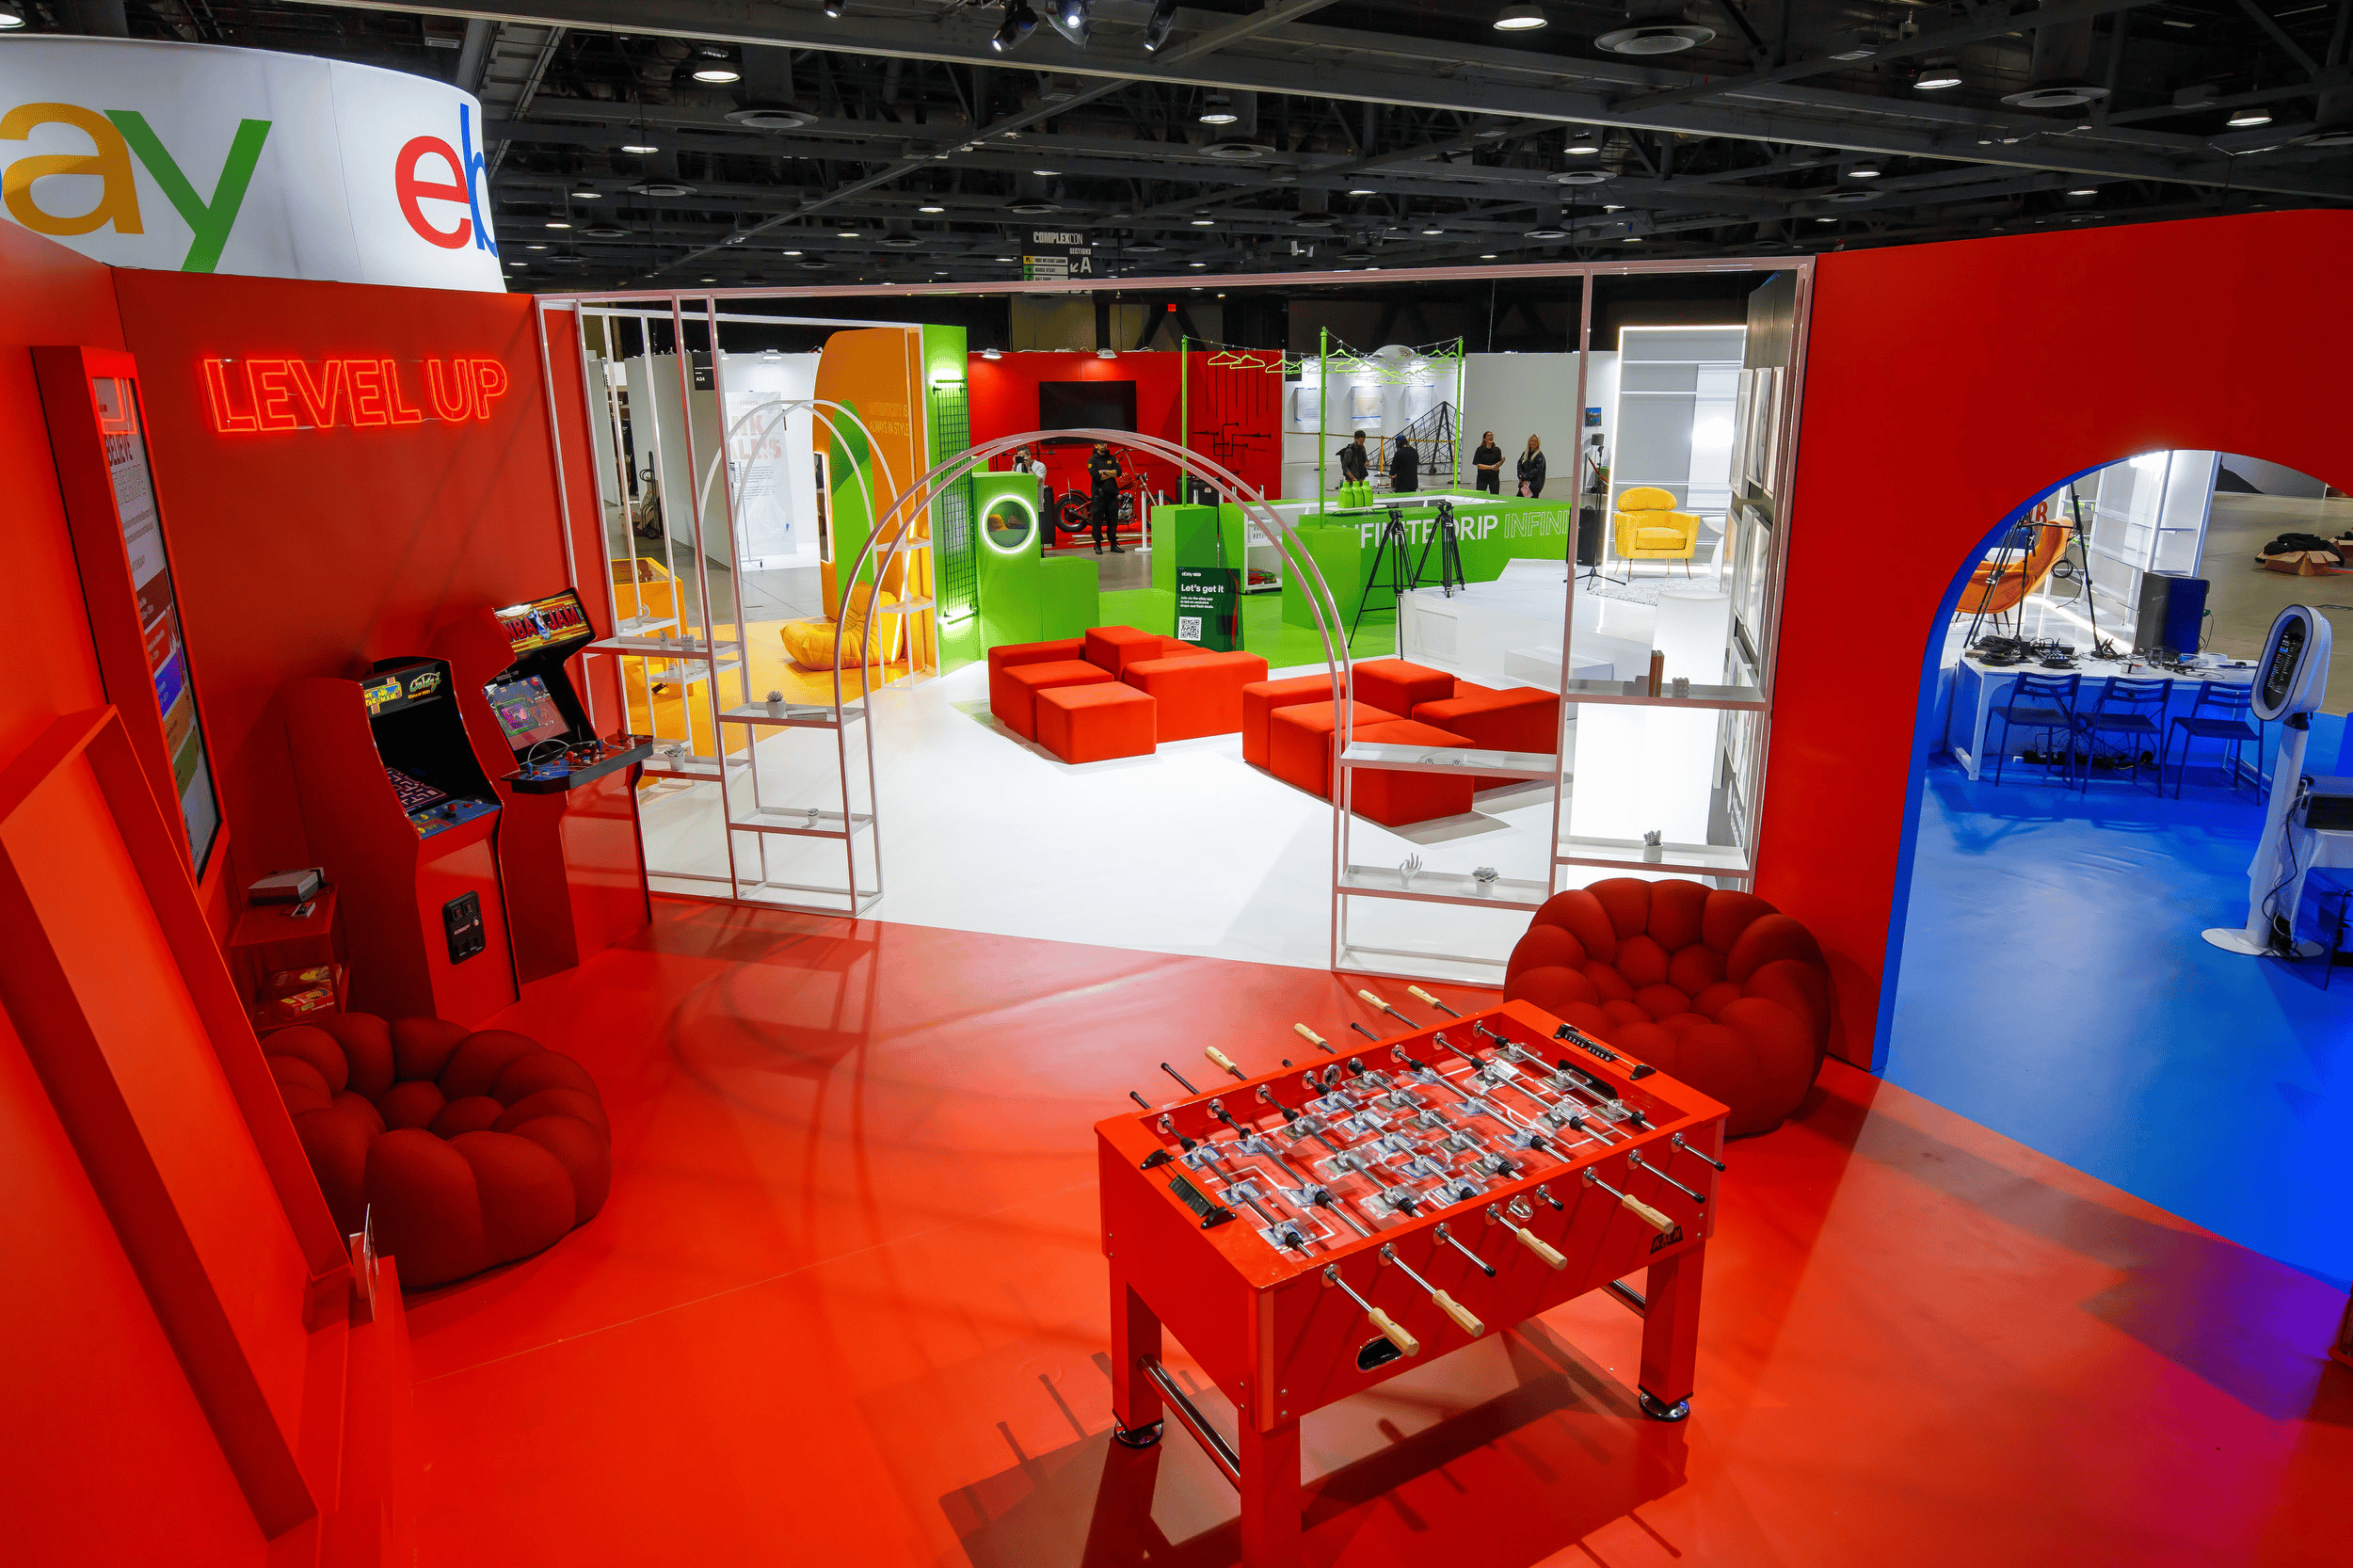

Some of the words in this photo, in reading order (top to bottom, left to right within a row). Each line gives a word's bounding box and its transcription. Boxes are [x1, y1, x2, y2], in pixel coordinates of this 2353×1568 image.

[0, 102, 272, 272] ay
[1033, 232, 1083, 245] COMPLEXCON
[1080, 256, 1092, 274] A
[203, 358, 423, 432] LEVEL
[426, 358, 508, 423] UP
[1504, 509, 1570, 538] INFINI
[1181, 584, 1201, 592] Let's
[1202, 584, 1217, 594] get
[1218, 584, 1225, 593] it
[502, 615, 539, 642] NBA
[547, 604, 584, 631] JAM
